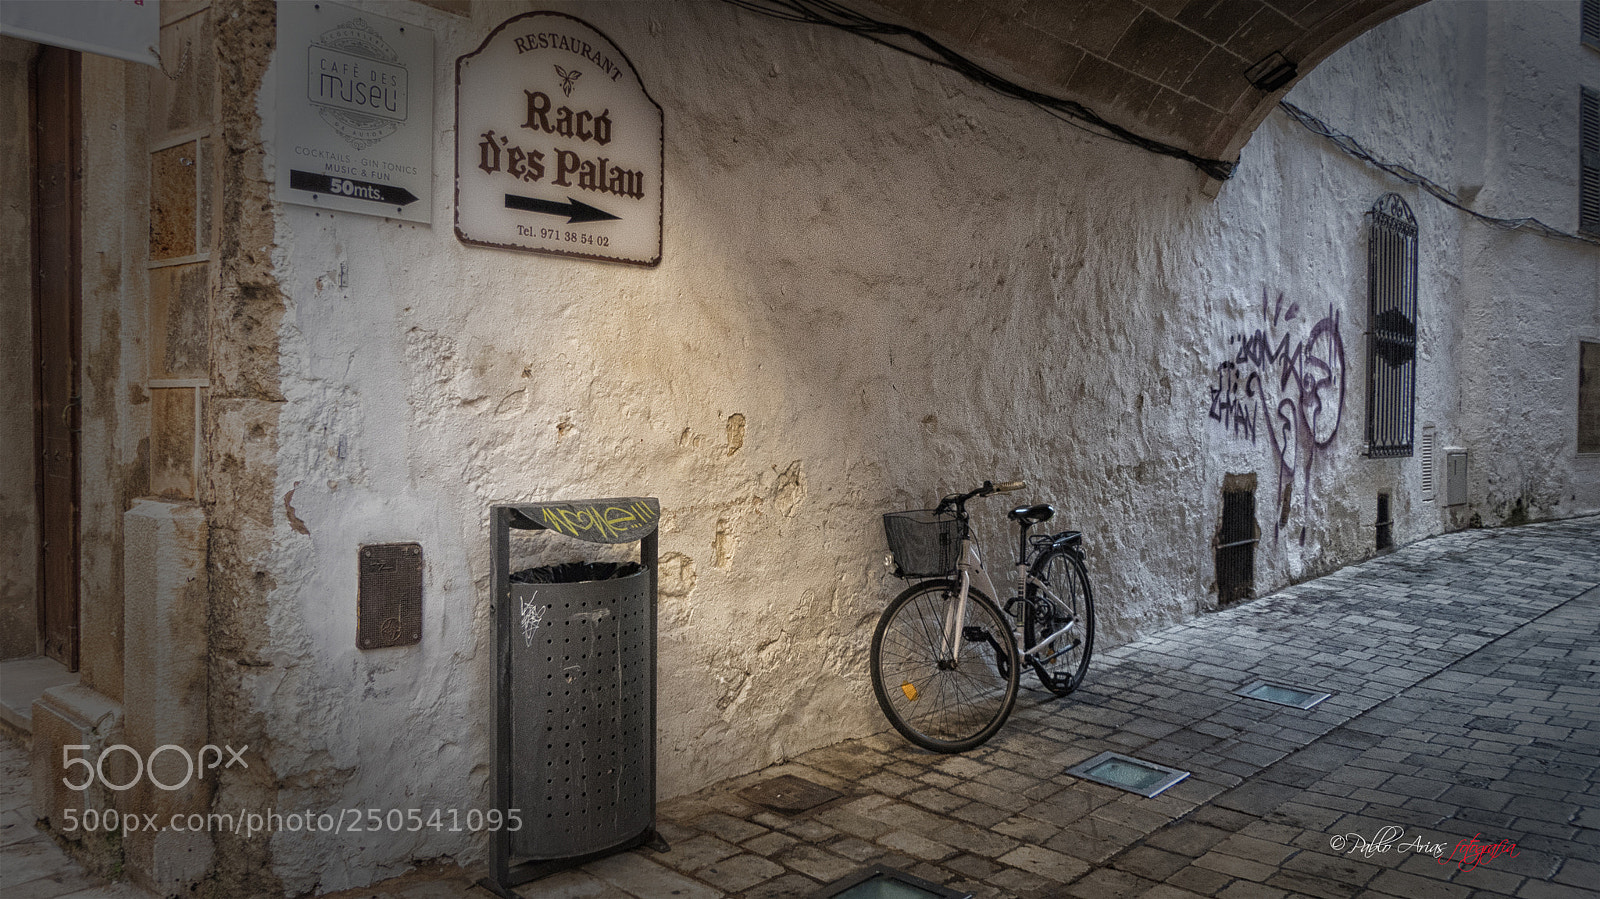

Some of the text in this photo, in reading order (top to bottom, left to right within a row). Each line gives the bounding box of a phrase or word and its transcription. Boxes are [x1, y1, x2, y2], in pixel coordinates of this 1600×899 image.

[514, 33, 623, 83] RESTAURANT
[370, 70, 397, 87] DES
[521, 89, 613, 146] Racó
[295, 146, 418, 175] COCKTAILS GIN TONICS
[324, 163, 390, 181] MUSIC & FUN
[478, 129, 645, 200] d'es Palau
[330, 178, 385, 201] 50mts.
[517, 225, 610, 247] Tel. 971 38 54 02
